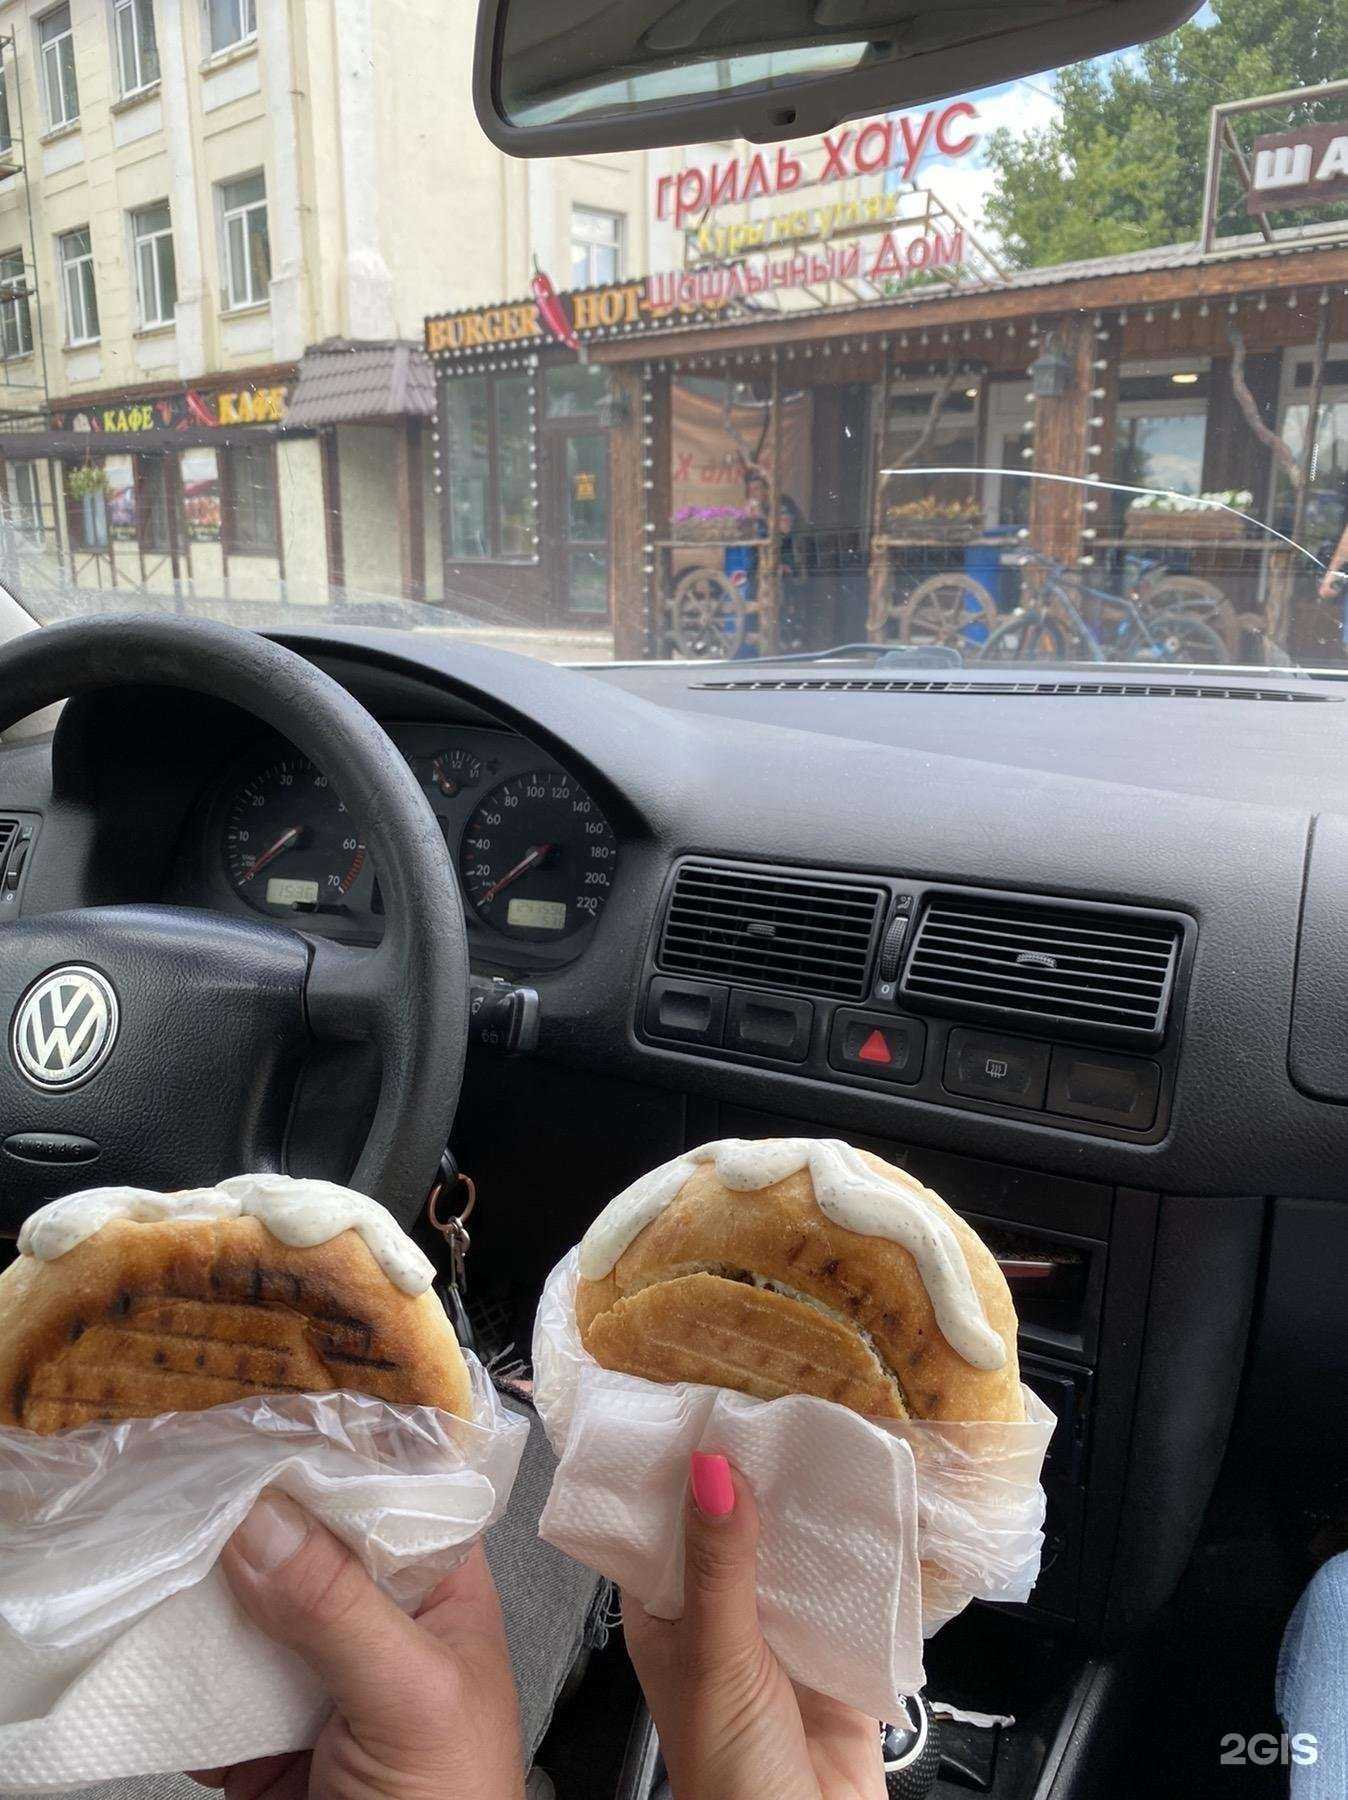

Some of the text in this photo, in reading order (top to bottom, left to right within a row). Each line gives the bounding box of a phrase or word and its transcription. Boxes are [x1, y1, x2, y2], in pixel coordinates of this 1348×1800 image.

[656, 101, 981, 231] гриль хаус
[425, 304, 545, 351] BURGER
[217, 386, 288, 427] КАФЕ
[103, 405, 154, 433] КАФЕ
[526, 785, 545, 798] 100
[552, 787, 570, 799] 120
[504, 795, 518, 807] 80
[572, 800, 591, 813] 140
[486, 813, 501, 825] 60
[585, 822, 604, 834] 160
[239, 830, 250, 842] 10
[342, 838, 357, 850] 60
[476, 838, 491, 850] 40
[591, 846, 609, 858] 180
[476, 864, 490, 876] 20
[327, 874, 341, 887] 70
[585, 872, 606, 885] 200
[577, 896, 599, 909] 220
